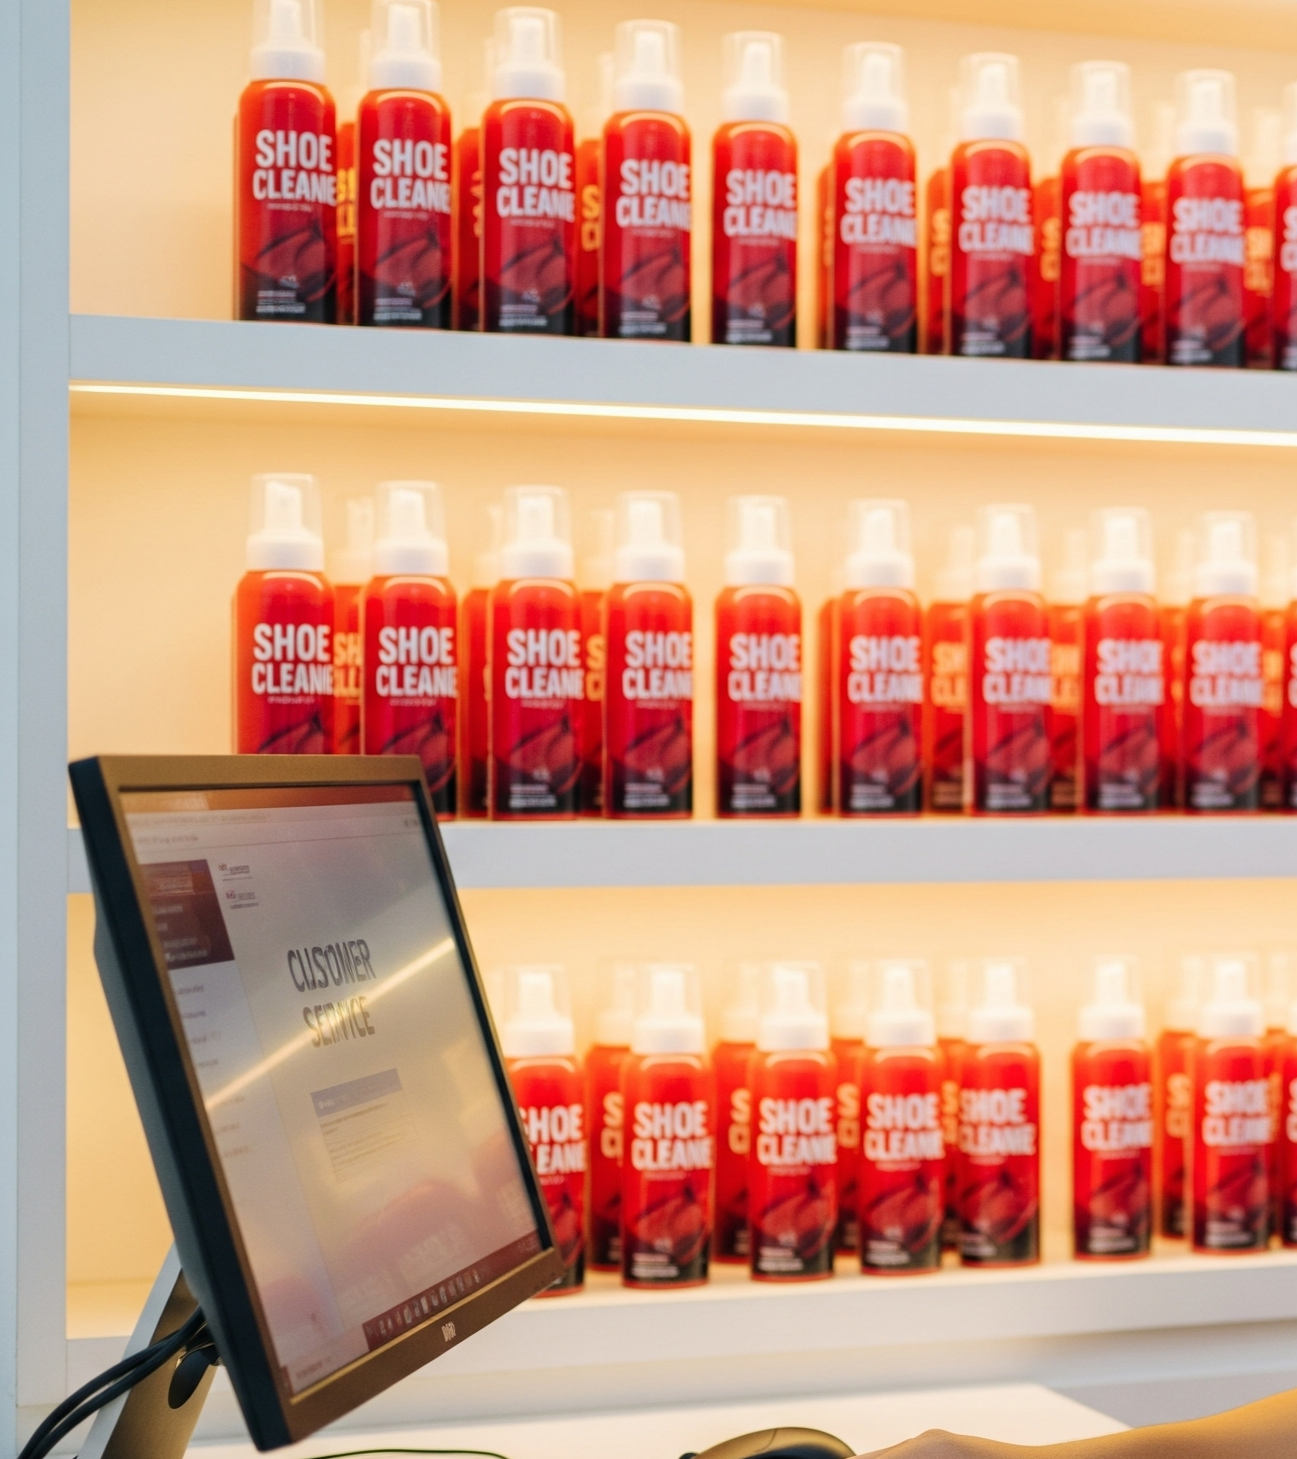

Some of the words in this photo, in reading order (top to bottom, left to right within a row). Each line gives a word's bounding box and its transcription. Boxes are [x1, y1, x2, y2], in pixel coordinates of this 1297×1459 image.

[256, 129, 333, 172] SHOE
[373, 138, 448, 180] SHOE
[499, 147, 573, 189] SHOE
[620, 158, 690, 199] SHOE
[726, 168, 796, 208] SHOE
[845, 177, 915, 216] SHOE
[961, 185, 1031, 223] SHOE
[1068, 190, 1140, 229] SHOE
[253, 623, 331, 661] SHOE
[378, 626, 453, 664] SHOE
[507, 628, 580, 667] SHOE
[625, 630, 691, 668] SHOE
[730, 632, 799, 670] SHOE
[850, 635, 920, 673] SHOE
[985, 636, 1051, 674] SHOE
[633, 1101, 708, 1138] SHOE
[759, 1097, 834, 1134] SHOE
[866, 1092, 939, 1130] SHOE
